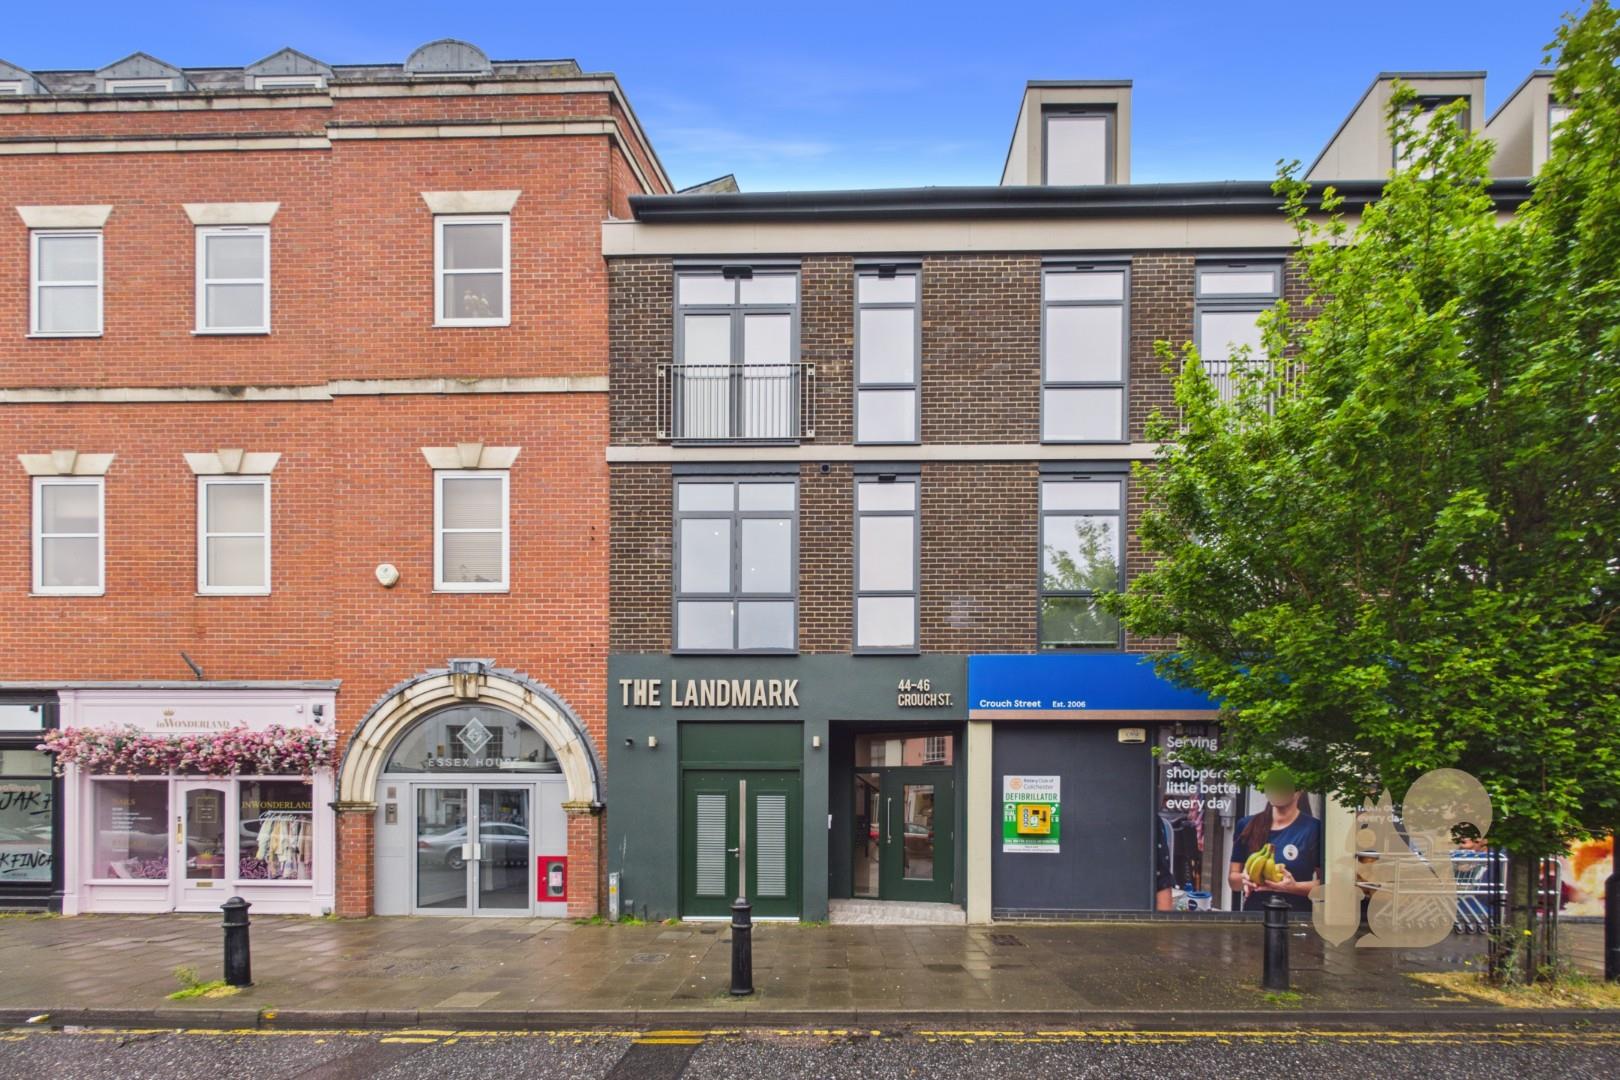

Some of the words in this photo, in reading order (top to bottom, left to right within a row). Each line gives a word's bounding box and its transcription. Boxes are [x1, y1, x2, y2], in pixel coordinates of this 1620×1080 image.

[898, 679, 930, 692] 44-46
[619, 679, 661, 707] THE
[671, 679, 800, 707] LANDMARK
[898, 693, 937, 706] CROUCH
[938, 693, 954, 706] ST.
[979, 699, 1012, 708] Crouch
[1014, 699, 1041, 708] Street
[1052, 700, 1066, 708] Est.
[1067, 700, 1086, 708] 2006
[1166, 735, 1218, 751] Serving
[428, 758, 470, 767] ESSEX
[1166, 781, 1198, 794] little
[1005, 792, 1058, 801] DEFIBRILLATOR
[1166, 799, 1205, 812] every
[1207, 797, 1232, 812] day
